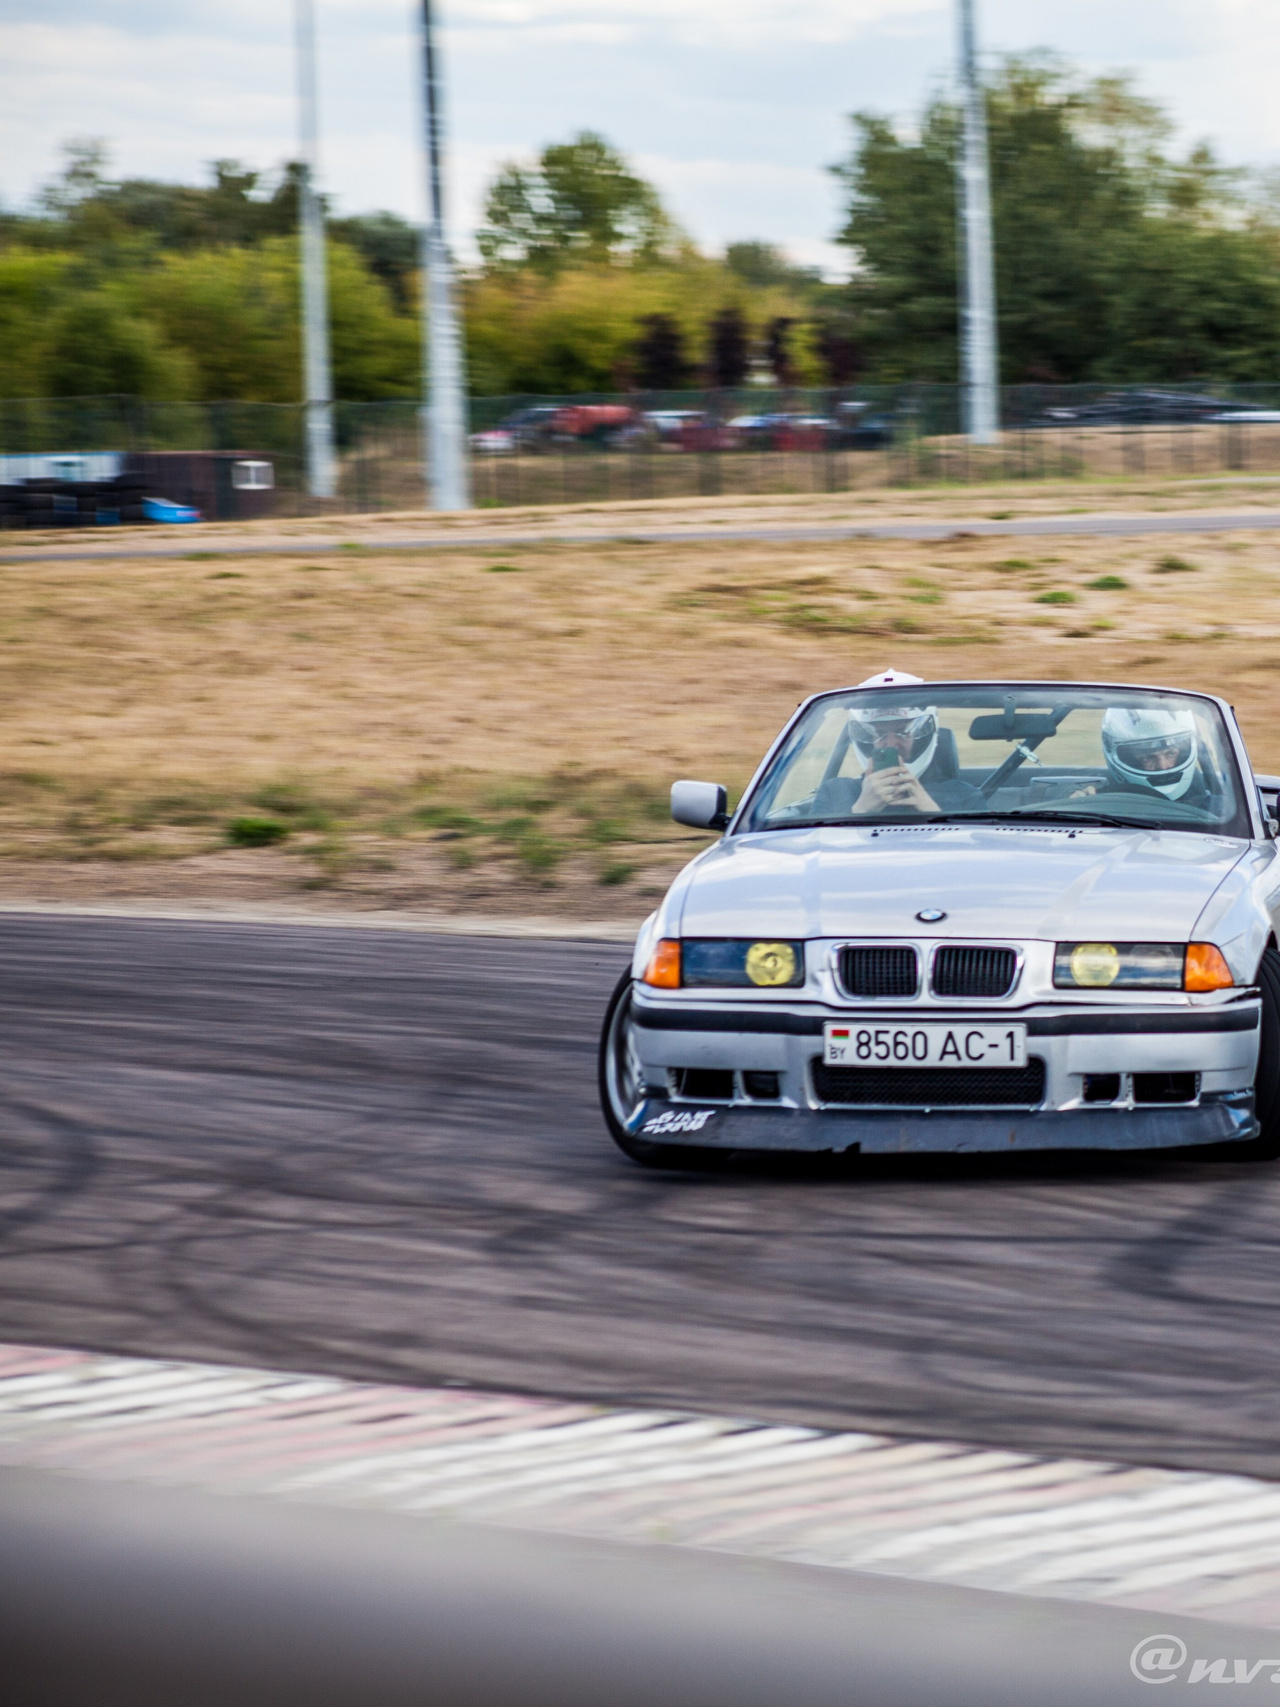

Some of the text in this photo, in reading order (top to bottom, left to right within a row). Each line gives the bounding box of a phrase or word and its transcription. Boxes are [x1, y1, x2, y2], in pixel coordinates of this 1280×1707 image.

[829, 1046, 847, 1060] BY
[855, 1029, 1016, 1061] 8560 AC-1
